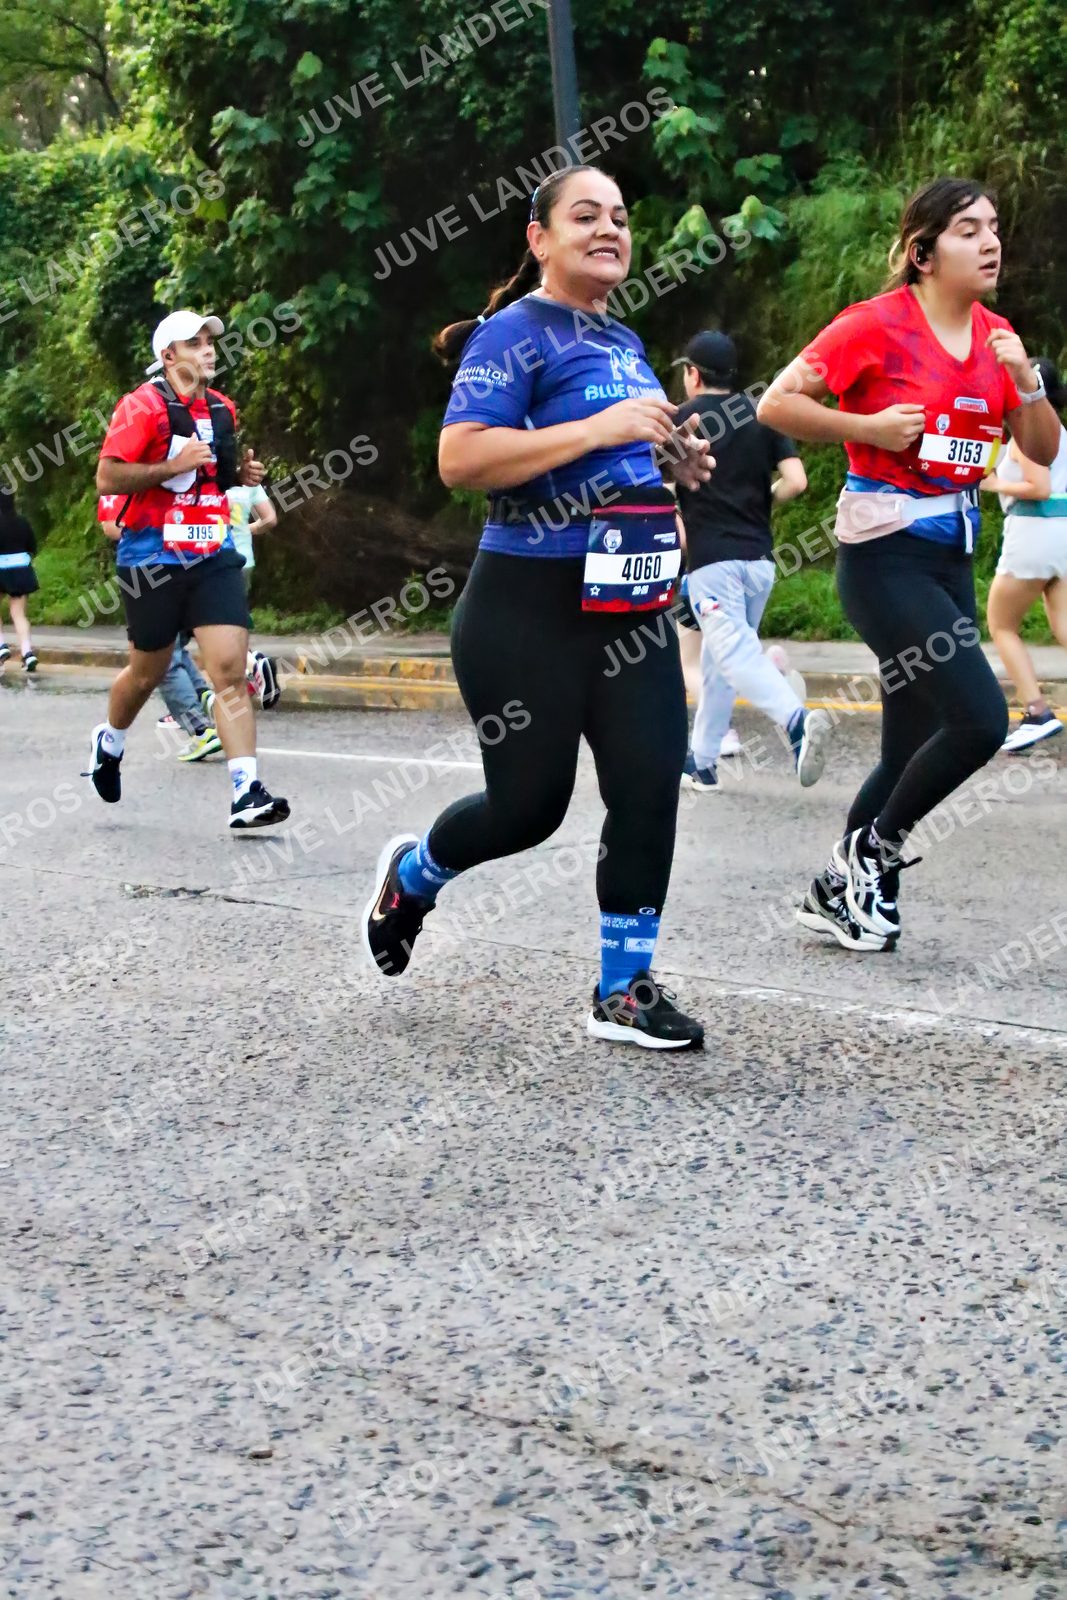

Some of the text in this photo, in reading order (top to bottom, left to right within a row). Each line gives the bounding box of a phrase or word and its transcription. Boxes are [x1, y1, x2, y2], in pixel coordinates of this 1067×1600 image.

[584, 384, 627, 400] BLUE
[948, 439, 983, 464] 3153
[188, 526, 213, 540] 3195
[622, 555, 662, 581] 4060
